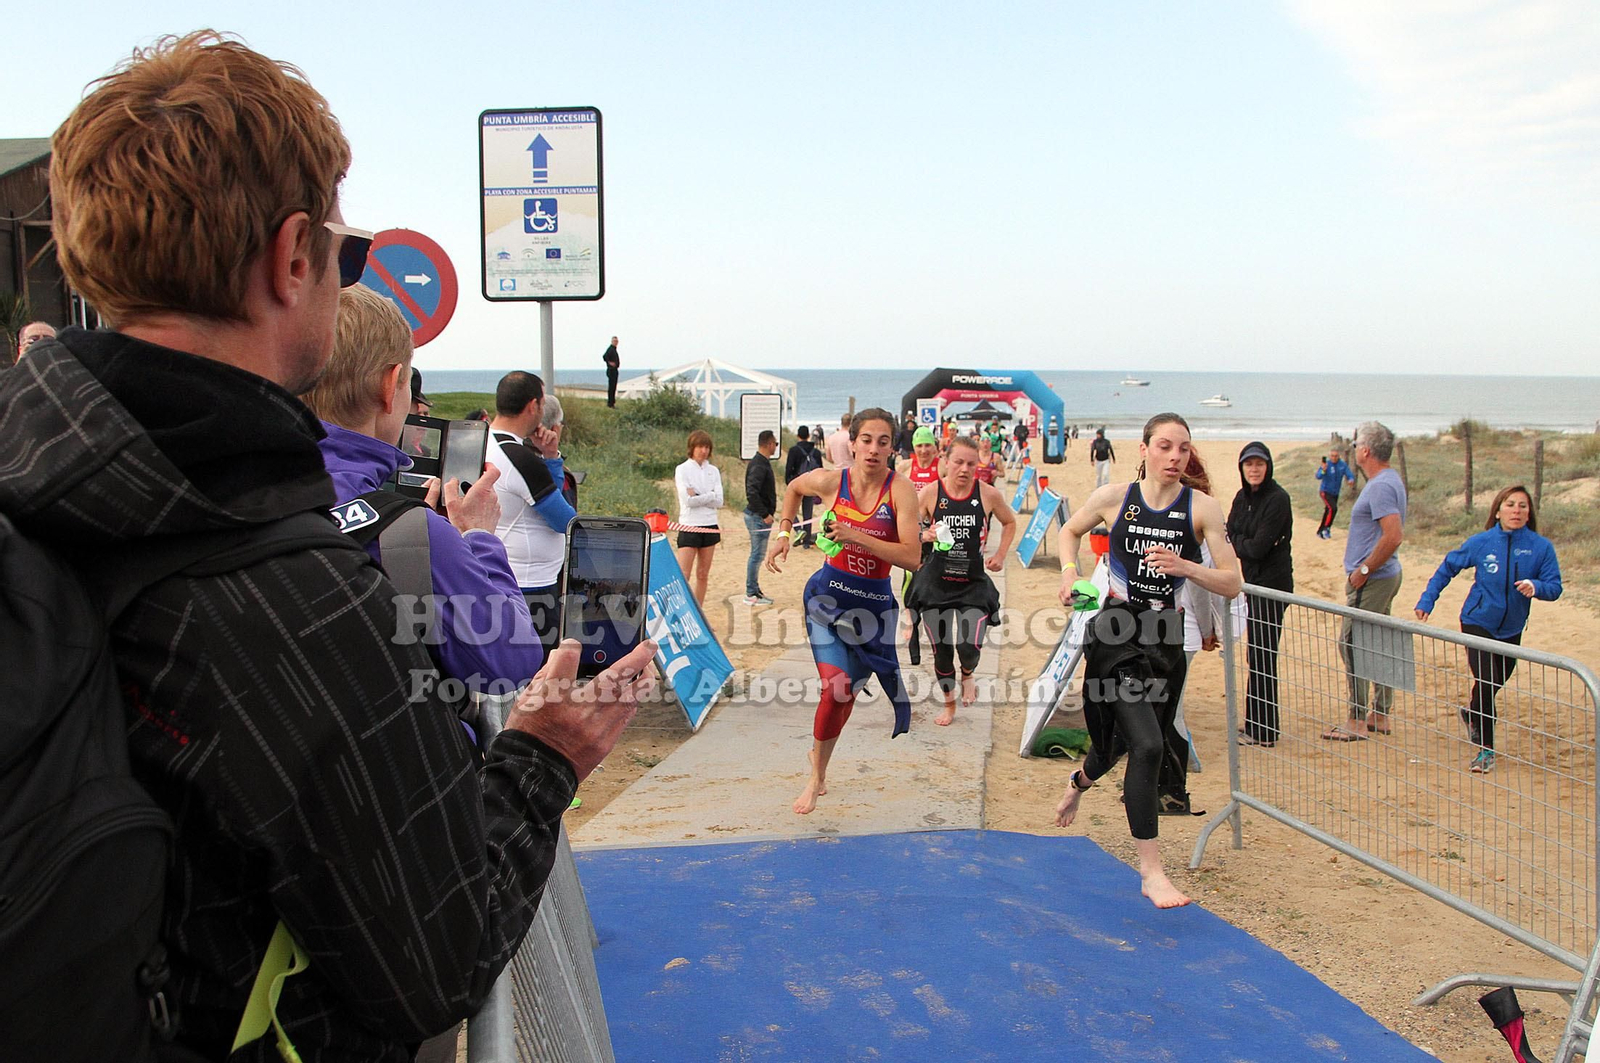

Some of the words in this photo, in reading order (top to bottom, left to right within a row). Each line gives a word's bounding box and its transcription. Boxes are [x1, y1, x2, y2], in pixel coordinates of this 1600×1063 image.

[483, 115, 512, 125] PUNTA
[514, 113, 548, 124] UMBRÍA
[552, 113, 597, 123] ACCESIBLE
[952, 375, 1013, 385] POWERADE
[942, 514, 976, 527] KITCHEN
[950, 528, 970, 539] GBR
[847, 554, 876, 575] ESP
[1128, 579, 1160, 591] VINCI
